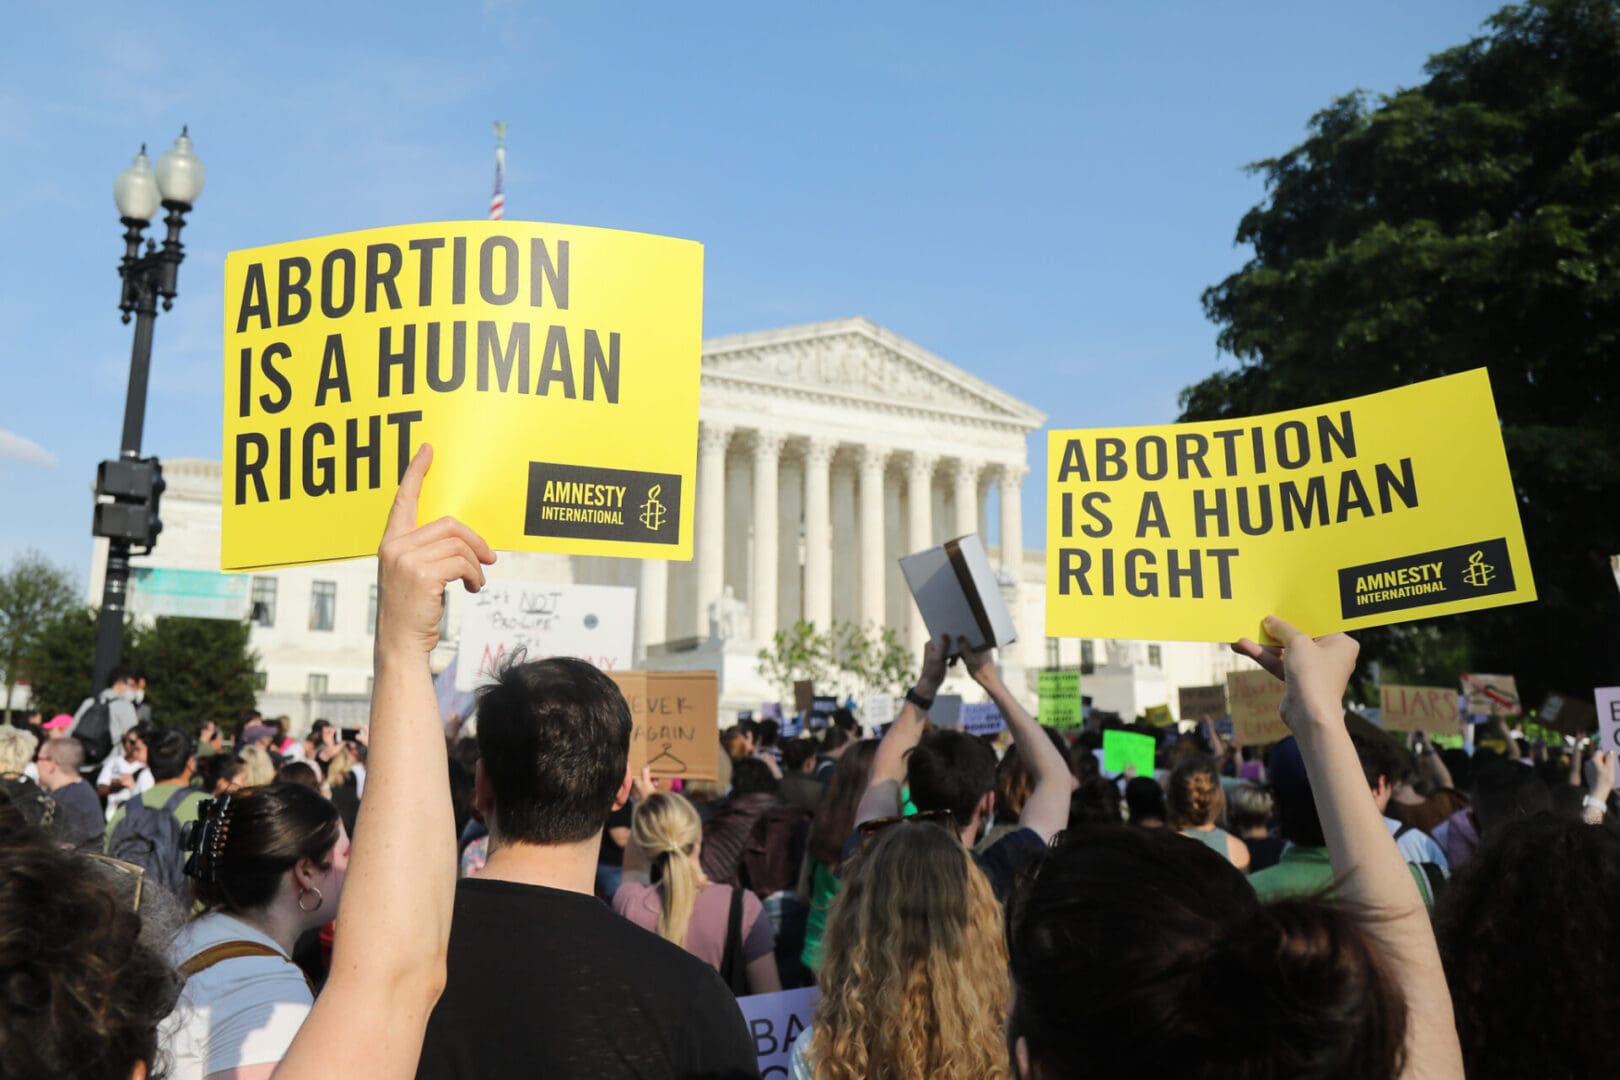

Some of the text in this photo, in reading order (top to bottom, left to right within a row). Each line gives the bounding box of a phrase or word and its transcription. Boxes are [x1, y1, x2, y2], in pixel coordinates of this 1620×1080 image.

[236, 235, 569, 333] ABORTION
[239, 320, 621, 418] IS A HUMAN
[235, 410, 423, 505] RIGHT
[1057, 410, 1357, 483] ABORTION
[543, 480, 626, 508] AMNESTY
[1061, 457, 1419, 539] IS A HUMAN
[541, 506, 624, 525] INTERNATIONAL
[1058, 548, 1240, 599] RIGHT
[1355, 562, 1444, 593] AMNESTY
[518, 591, 563, 612] NOT
[1356, 580, 1447, 605] INTERNATIONAL
[630, 696, 695, 715] EVER
[1383, 687, 1457, 721] LIARS
[633, 725, 696, 742] AGAIN
